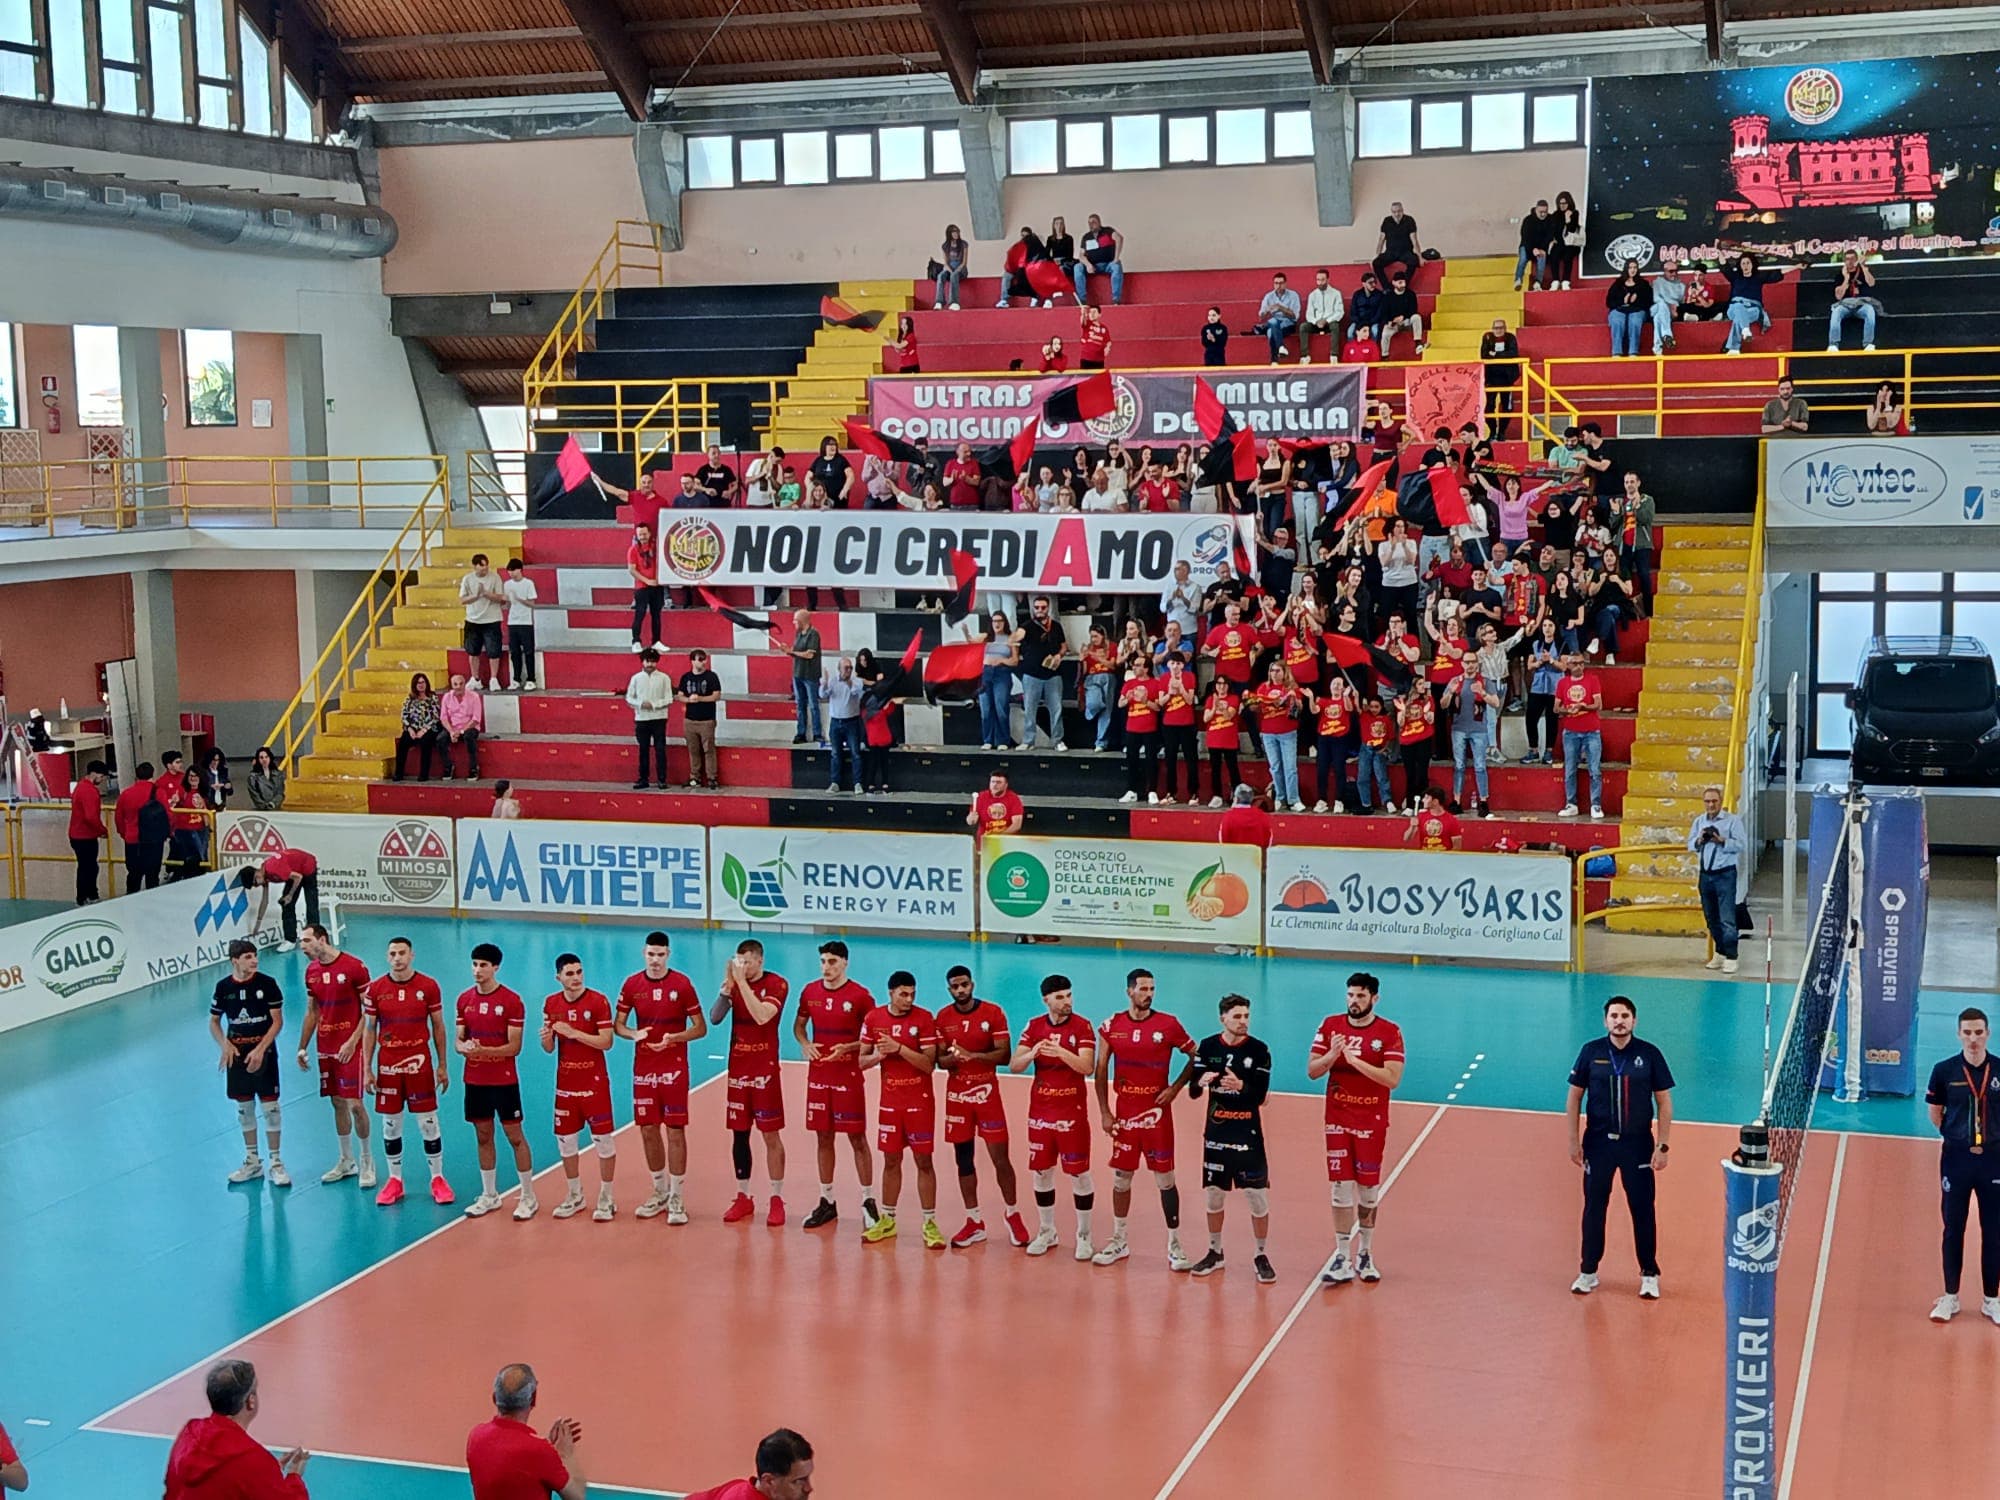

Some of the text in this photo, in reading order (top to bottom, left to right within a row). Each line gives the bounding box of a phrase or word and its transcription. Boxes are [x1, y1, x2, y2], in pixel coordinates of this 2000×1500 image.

[913, 383, 1033, 408] ULTRAS
[1216, 381, 1308, 404] MILLE
[1806, 461, 1916, 505] Movitec
[729, 517, 1173, 587] NOI CI CREDIAMO
[539, 843, 702, 871] GIUSEPPE
[1054, 850, 1127, 862] CONSORZIO
[381, 860, 447, 875] MIMOSA
[803, 862, 964, 892] RENOVARE
[1054, 861, 1144, 874] PER LA TUTELA
[398, 879, 433, 889] PIZZERIA
[540, 867, 703, 910] MIELE
[1054, 872, 1175, 888] DELLE CLEMENTINE
[1054, 884, 1156, 898] DI CALABRIA IGP
[803, 895, 956, 916] ENERGY FARM
[1270, 915, 1283, 928] Le
[1285, 916, 1343, 931] Clementine
[1346, 918, 1359, 932] da
[1361, 921, 1419, 936] agricoltura
[1422, 922, 1472, 939] Biologica
[1482, 925, 1541, 942] Corigliano
[45, 935, 115, 975] GALLO
[1882, 915, 1900, 1002] SPROVIERI
[147, 953, 192, 981] Max
[826, 998, 834, 1011] 3
[961, 1020, 970, 1033] 7
[1132, 1029, 1141, 1042] 6
[1348, 1035, 1364, 1049] 22
[1226, 1054, 1234, 1067] 2
